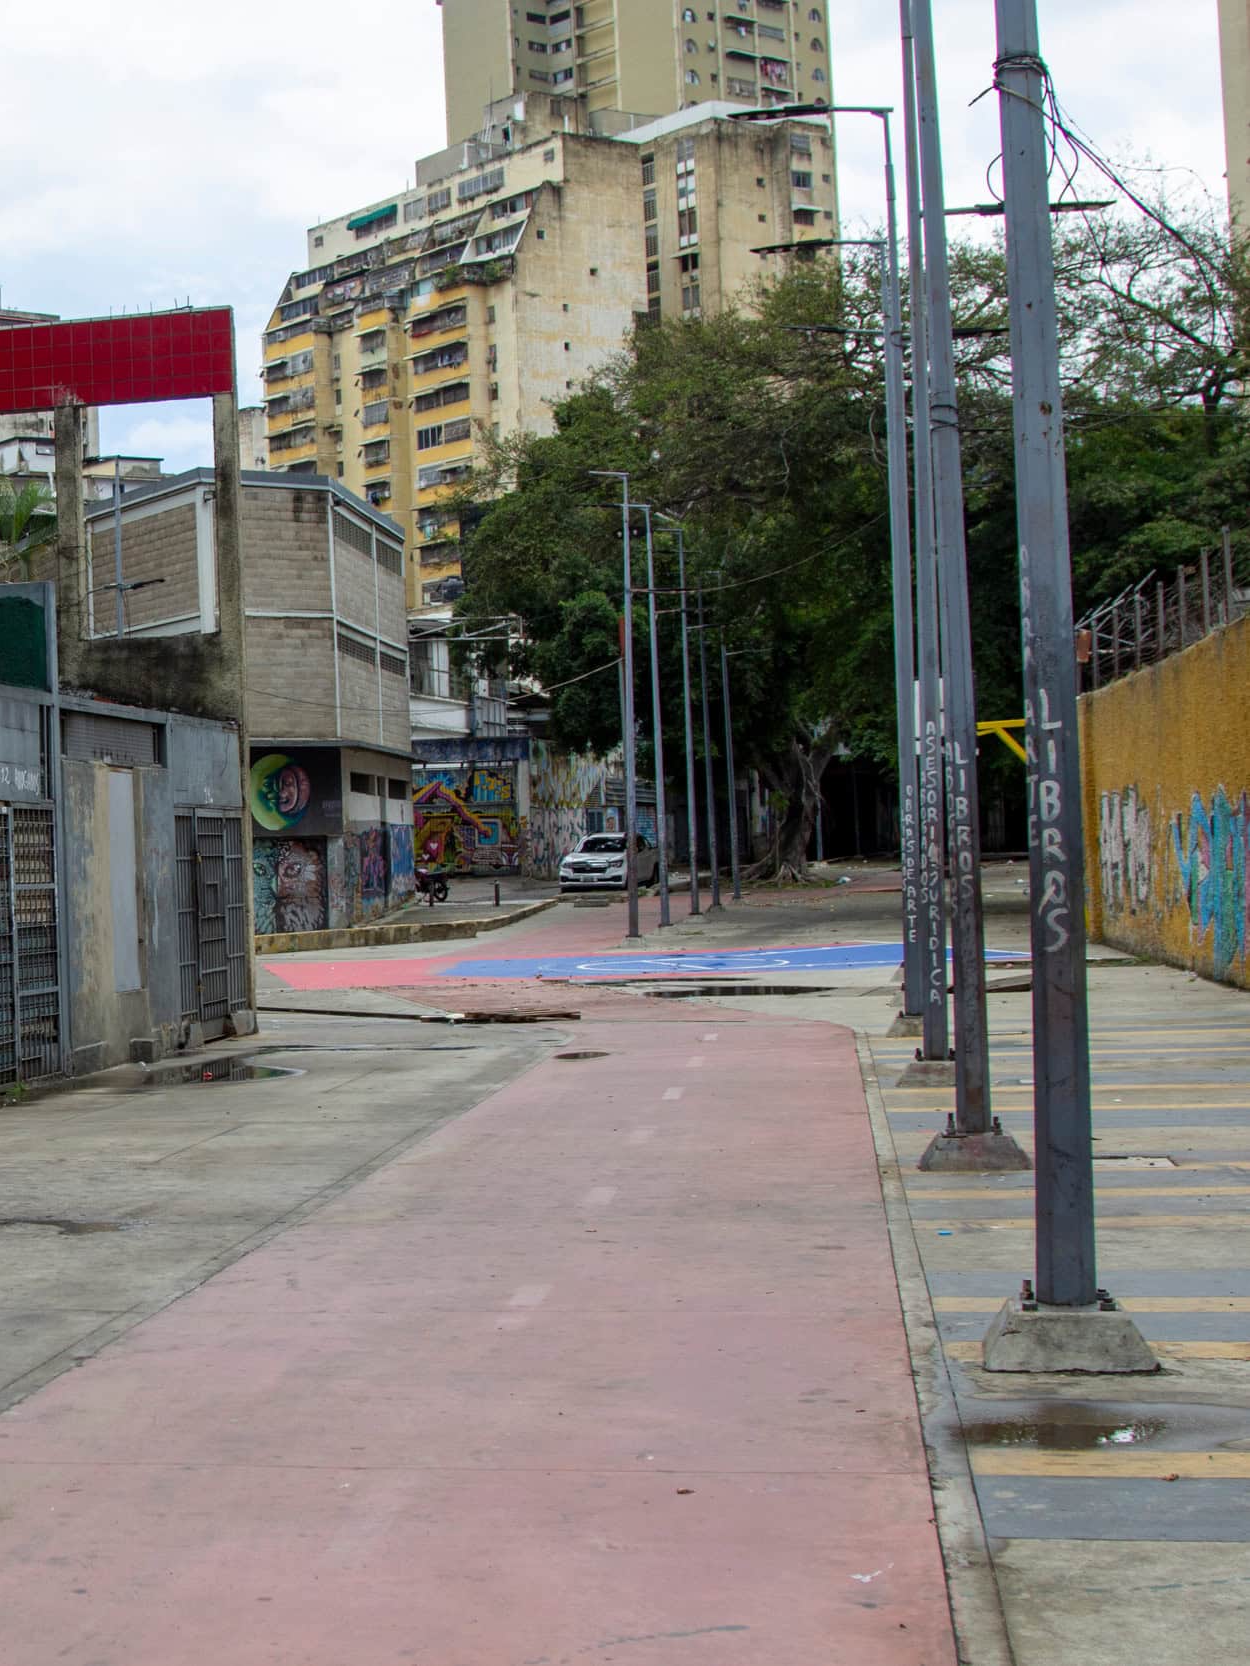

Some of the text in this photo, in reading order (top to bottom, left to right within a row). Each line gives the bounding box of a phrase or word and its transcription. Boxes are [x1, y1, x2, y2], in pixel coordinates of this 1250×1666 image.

[953, 741, 975, 900] LIBROS
[1025, 699, 1040, 847] ARTE
[1038, 687, 1070, 953] LIBROS
[906, 885, 918, 944] ARTE
